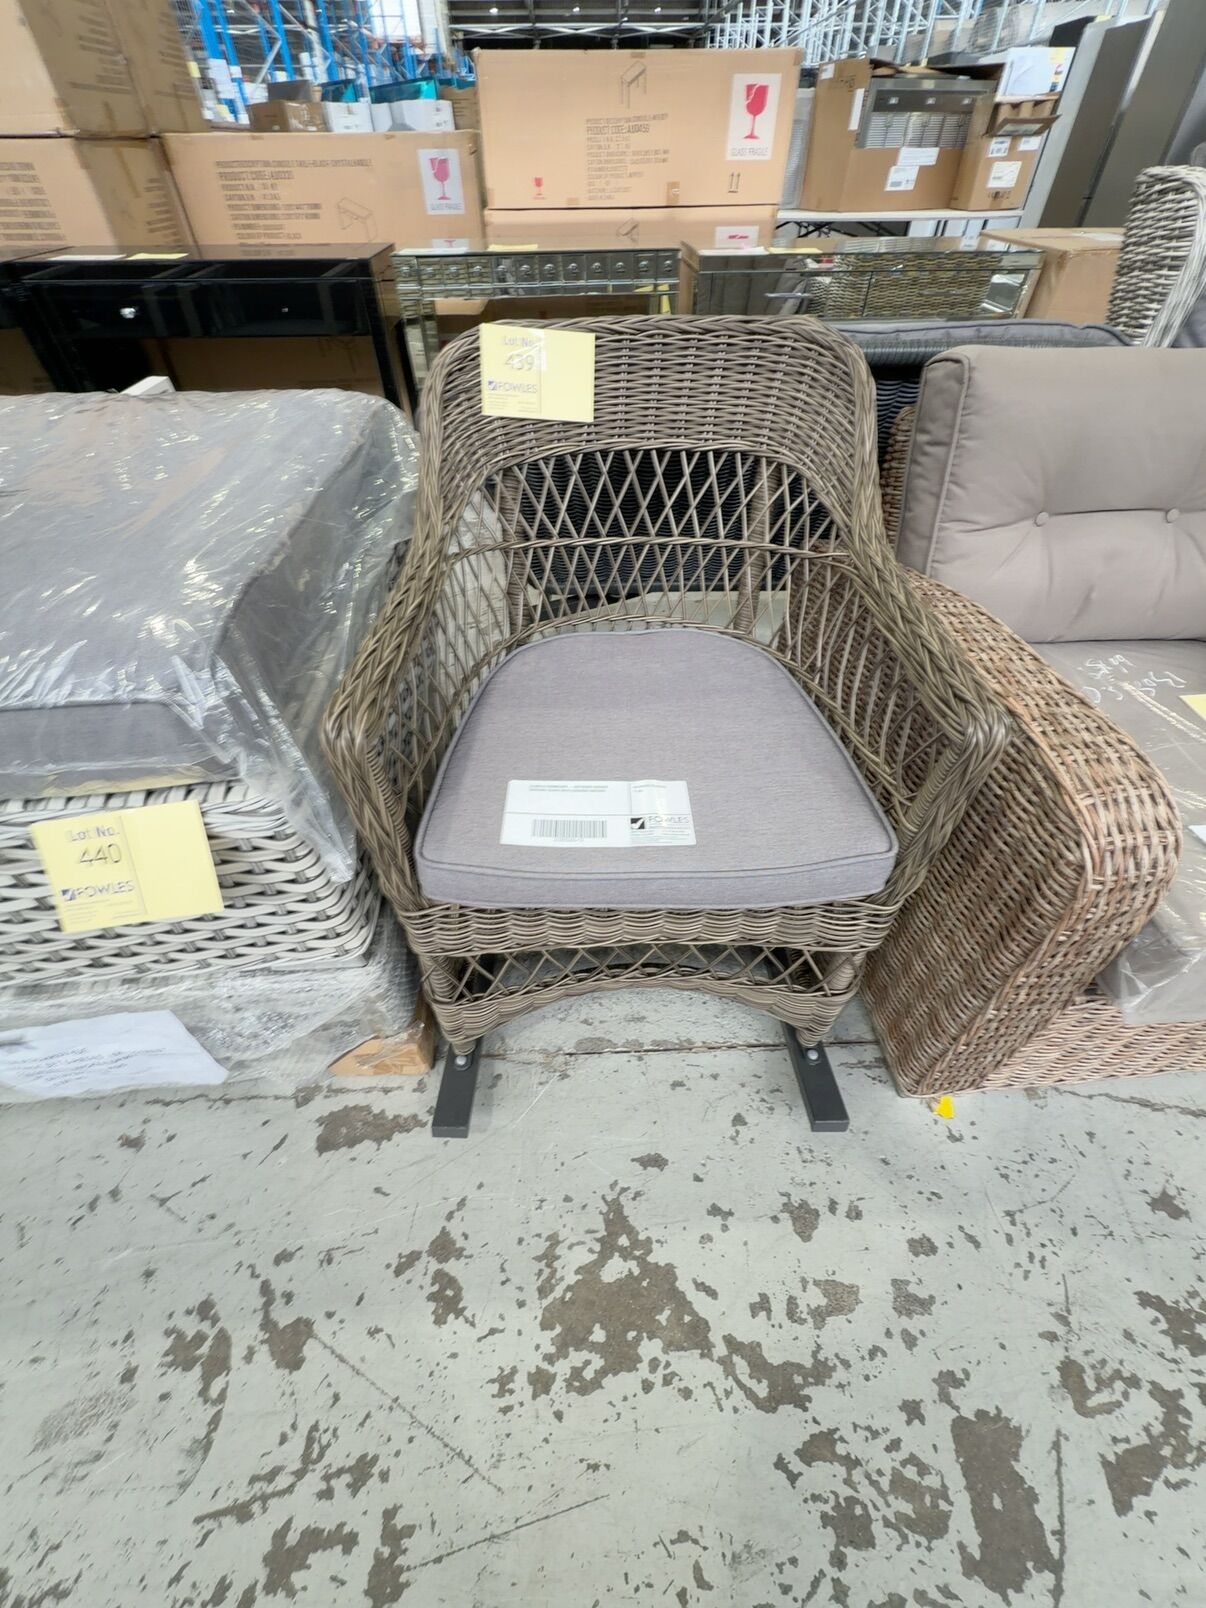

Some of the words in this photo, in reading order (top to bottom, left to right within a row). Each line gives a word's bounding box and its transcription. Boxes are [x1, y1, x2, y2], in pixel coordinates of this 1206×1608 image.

[503, 335, 517, 346] Lot
[504, 352, 535, 371] 439
[498, 381, 538, 393] FOWLES
[67, 830, 92, 843] Lot
[79, 843, 122, 865] 440
[75, 880, 136, 898] FOWLES
